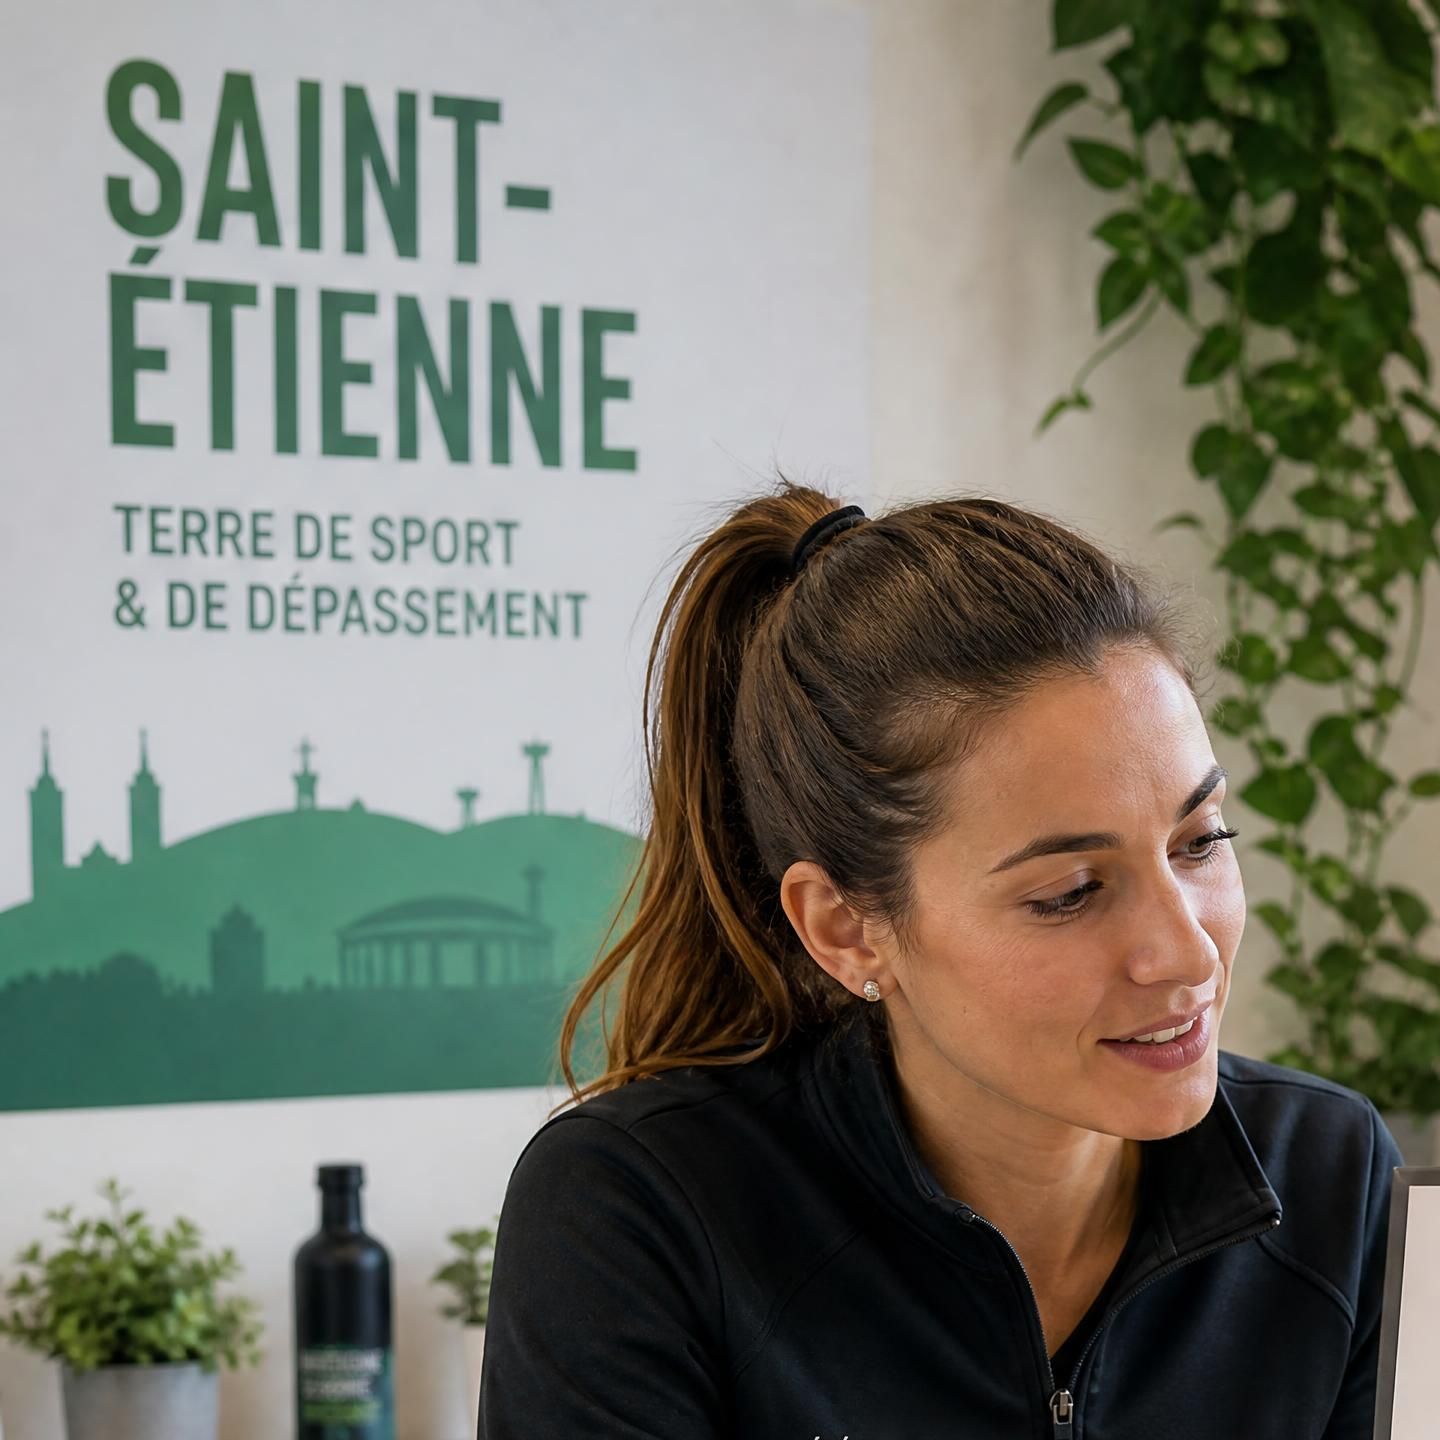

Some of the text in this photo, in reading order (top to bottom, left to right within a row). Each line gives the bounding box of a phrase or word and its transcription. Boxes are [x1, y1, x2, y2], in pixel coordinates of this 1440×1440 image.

[105, 58, 551, 264] SAINT-
[109, 246, 638, 472] ÉTIENNE
[113, 504, 520, 567] TERRE DE SPORT
[114, 573, 588, 639] & DE DÉPASSEMENT
